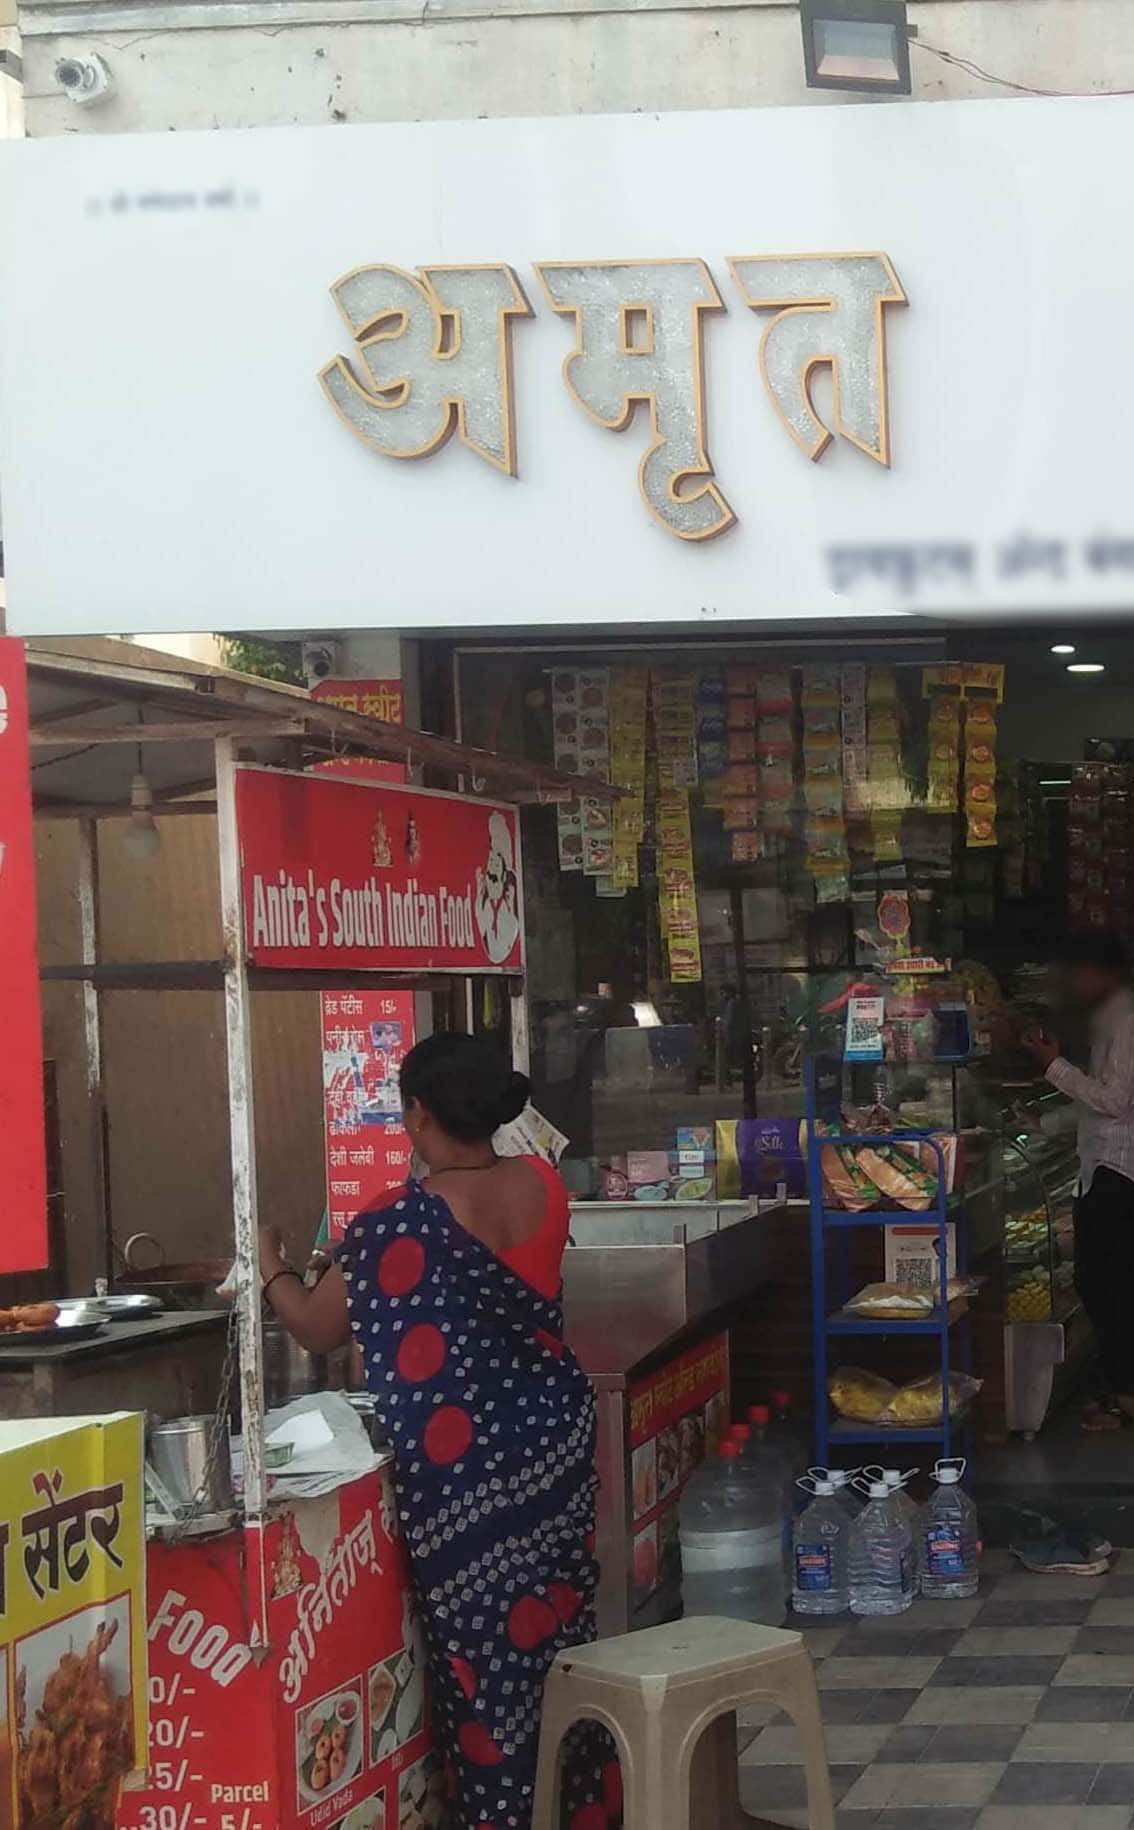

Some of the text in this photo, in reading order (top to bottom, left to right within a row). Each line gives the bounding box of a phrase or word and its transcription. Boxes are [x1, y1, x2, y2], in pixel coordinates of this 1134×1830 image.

[316, 250, 911, 542] अमृत
[253, 868, 476, 948] Anita's South Indian Food
[21, 1469, 124, 1600] सेंटर
[148, 1715, 205, 1749] 0/-
[148, 1759, 203, 1792] 5/-
[210, 1780, 270, 1804] Parcel
